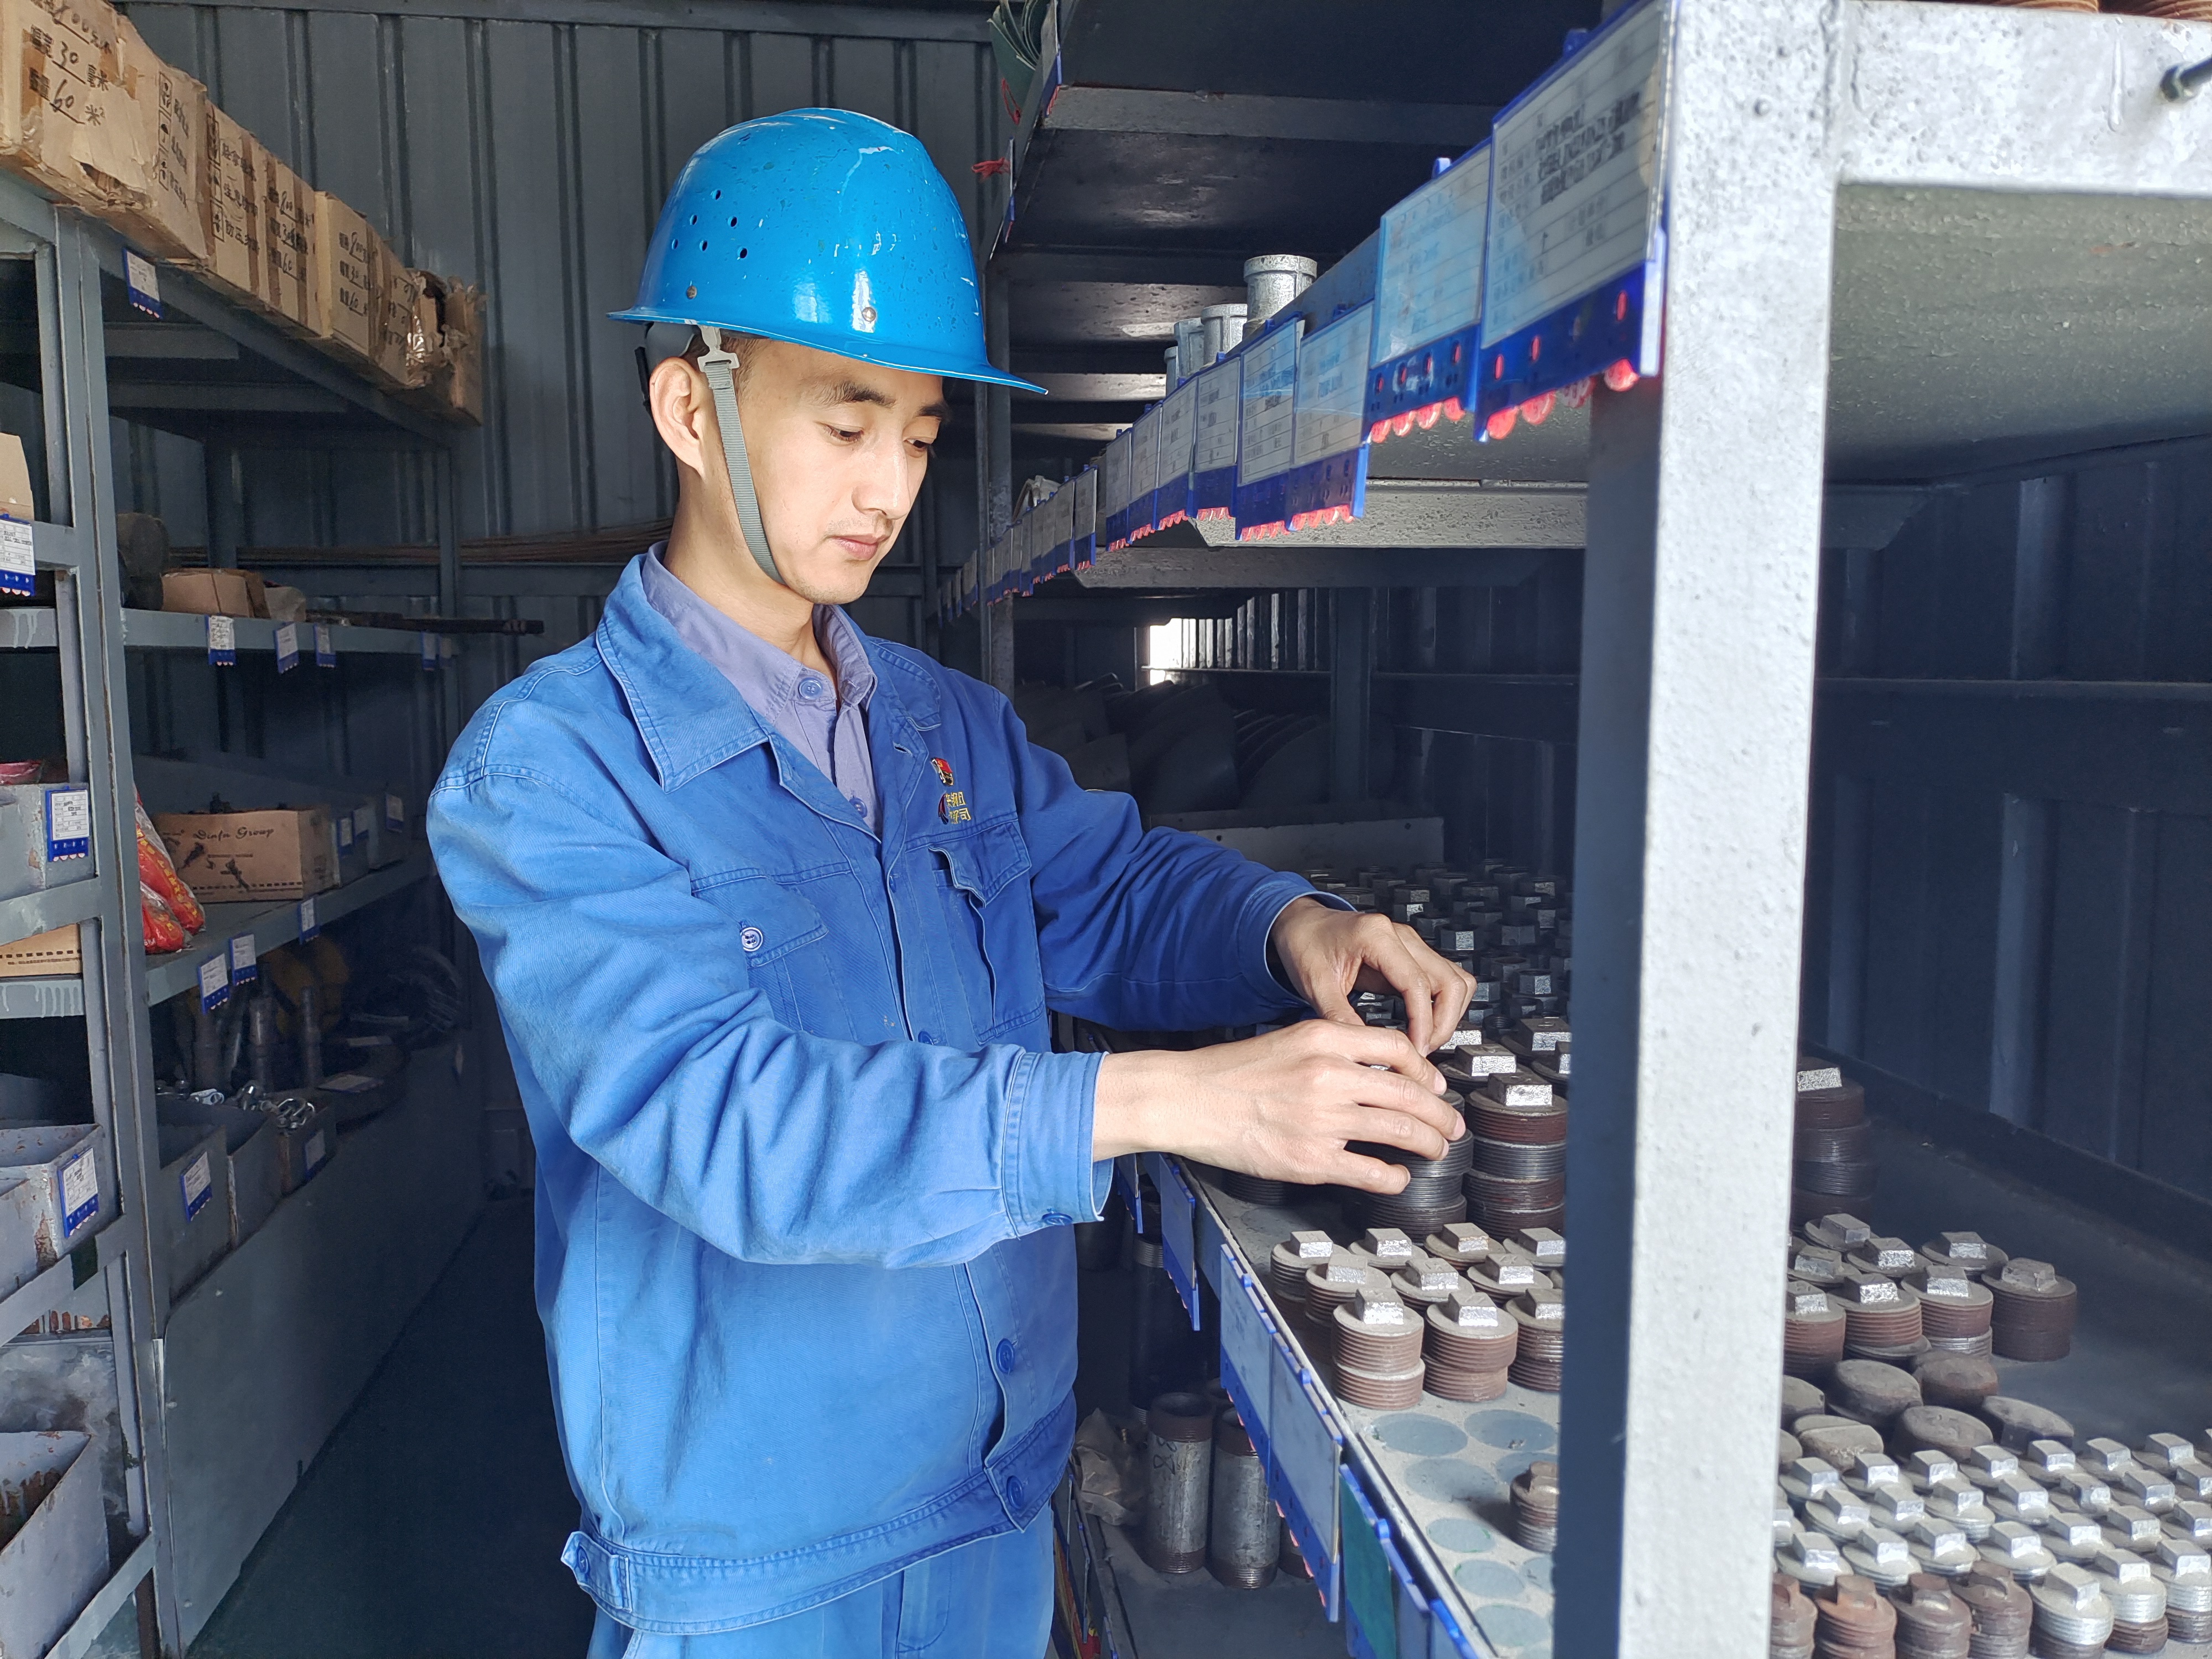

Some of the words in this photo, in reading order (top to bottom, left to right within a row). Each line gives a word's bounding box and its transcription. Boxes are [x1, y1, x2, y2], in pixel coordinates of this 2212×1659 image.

[60, 40, 79, 67] 30
[52, 79, 75, 113] 60
[235, 826, 275, 839] Group
